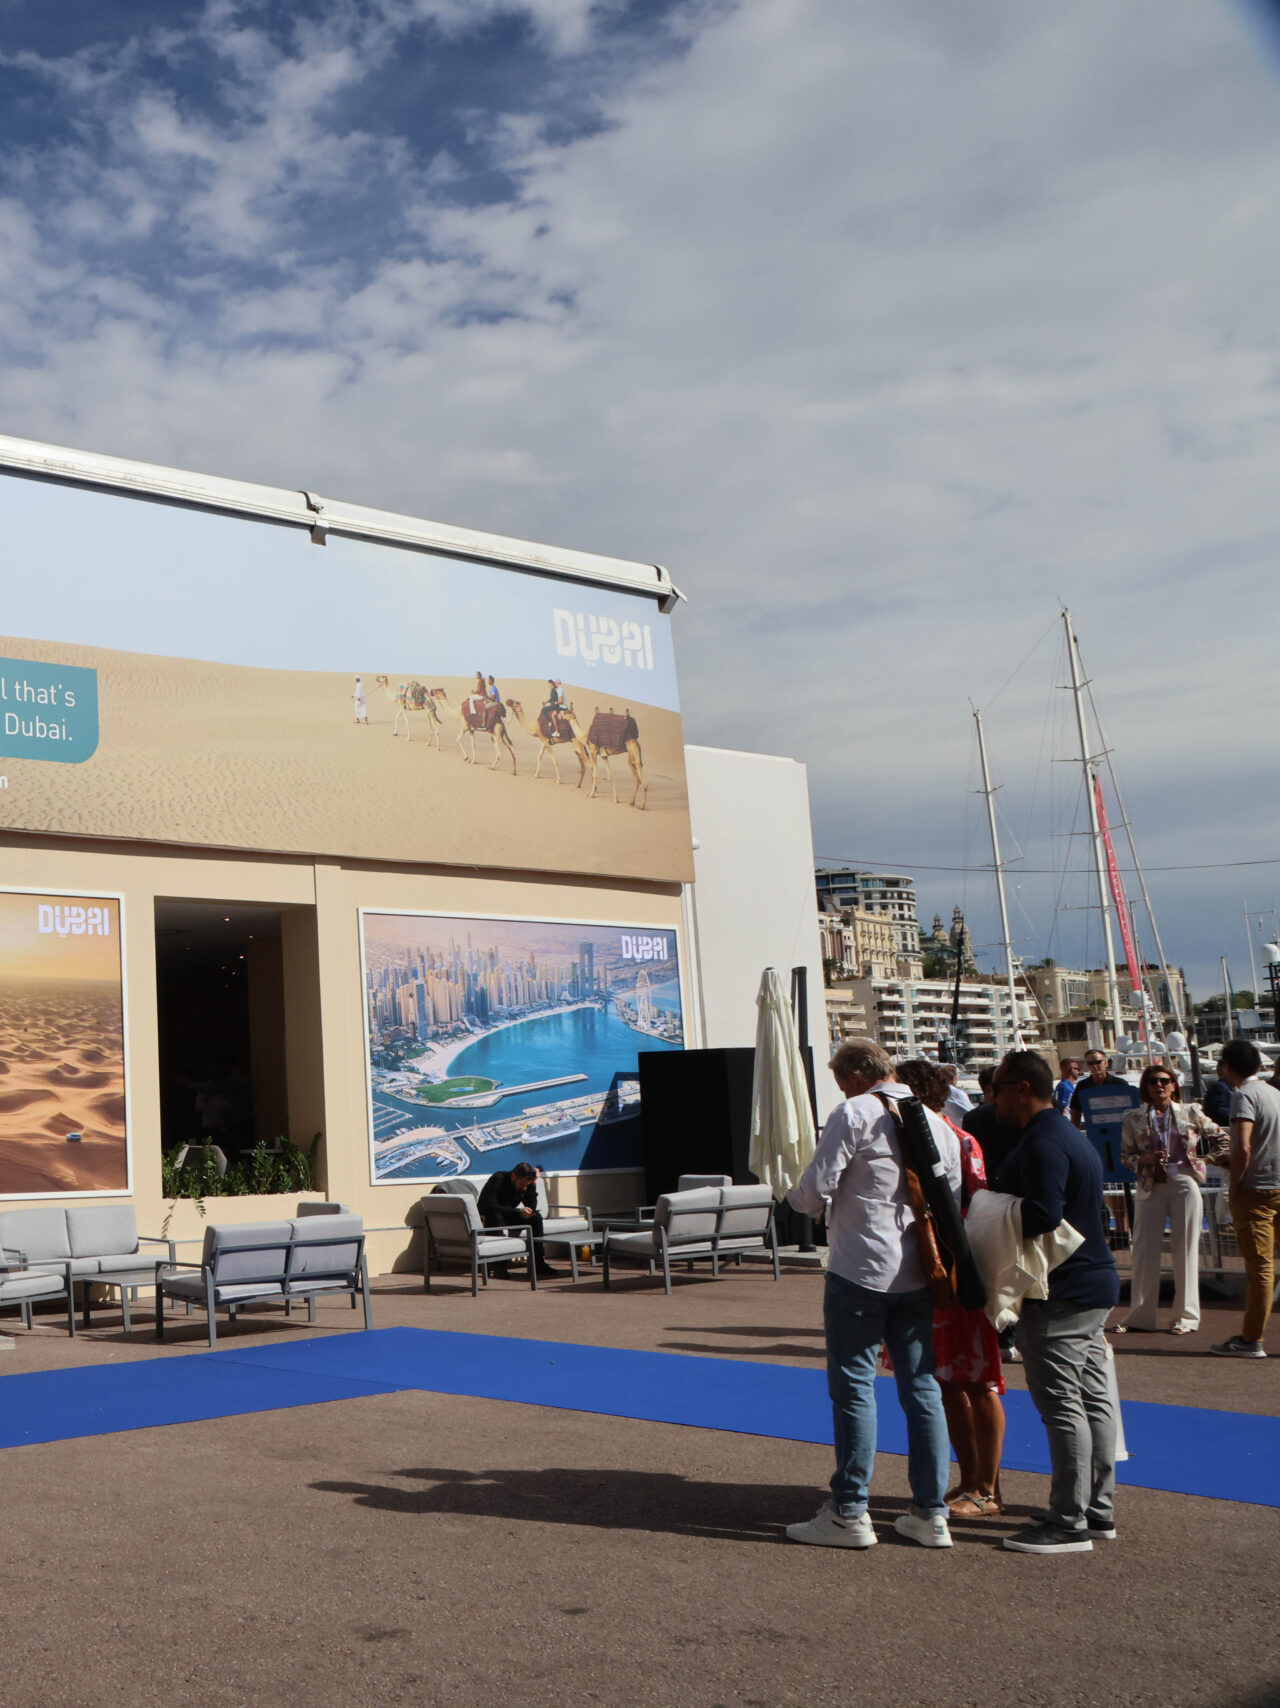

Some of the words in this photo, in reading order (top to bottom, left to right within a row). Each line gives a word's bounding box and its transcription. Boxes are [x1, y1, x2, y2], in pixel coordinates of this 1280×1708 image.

[553, 608, 655, 671] DUBAI
[5, 712, 73, 741] Dubai.
[38, 904, 109, 938] DUBAI
[621, 935, 668, 962] DUBAI
